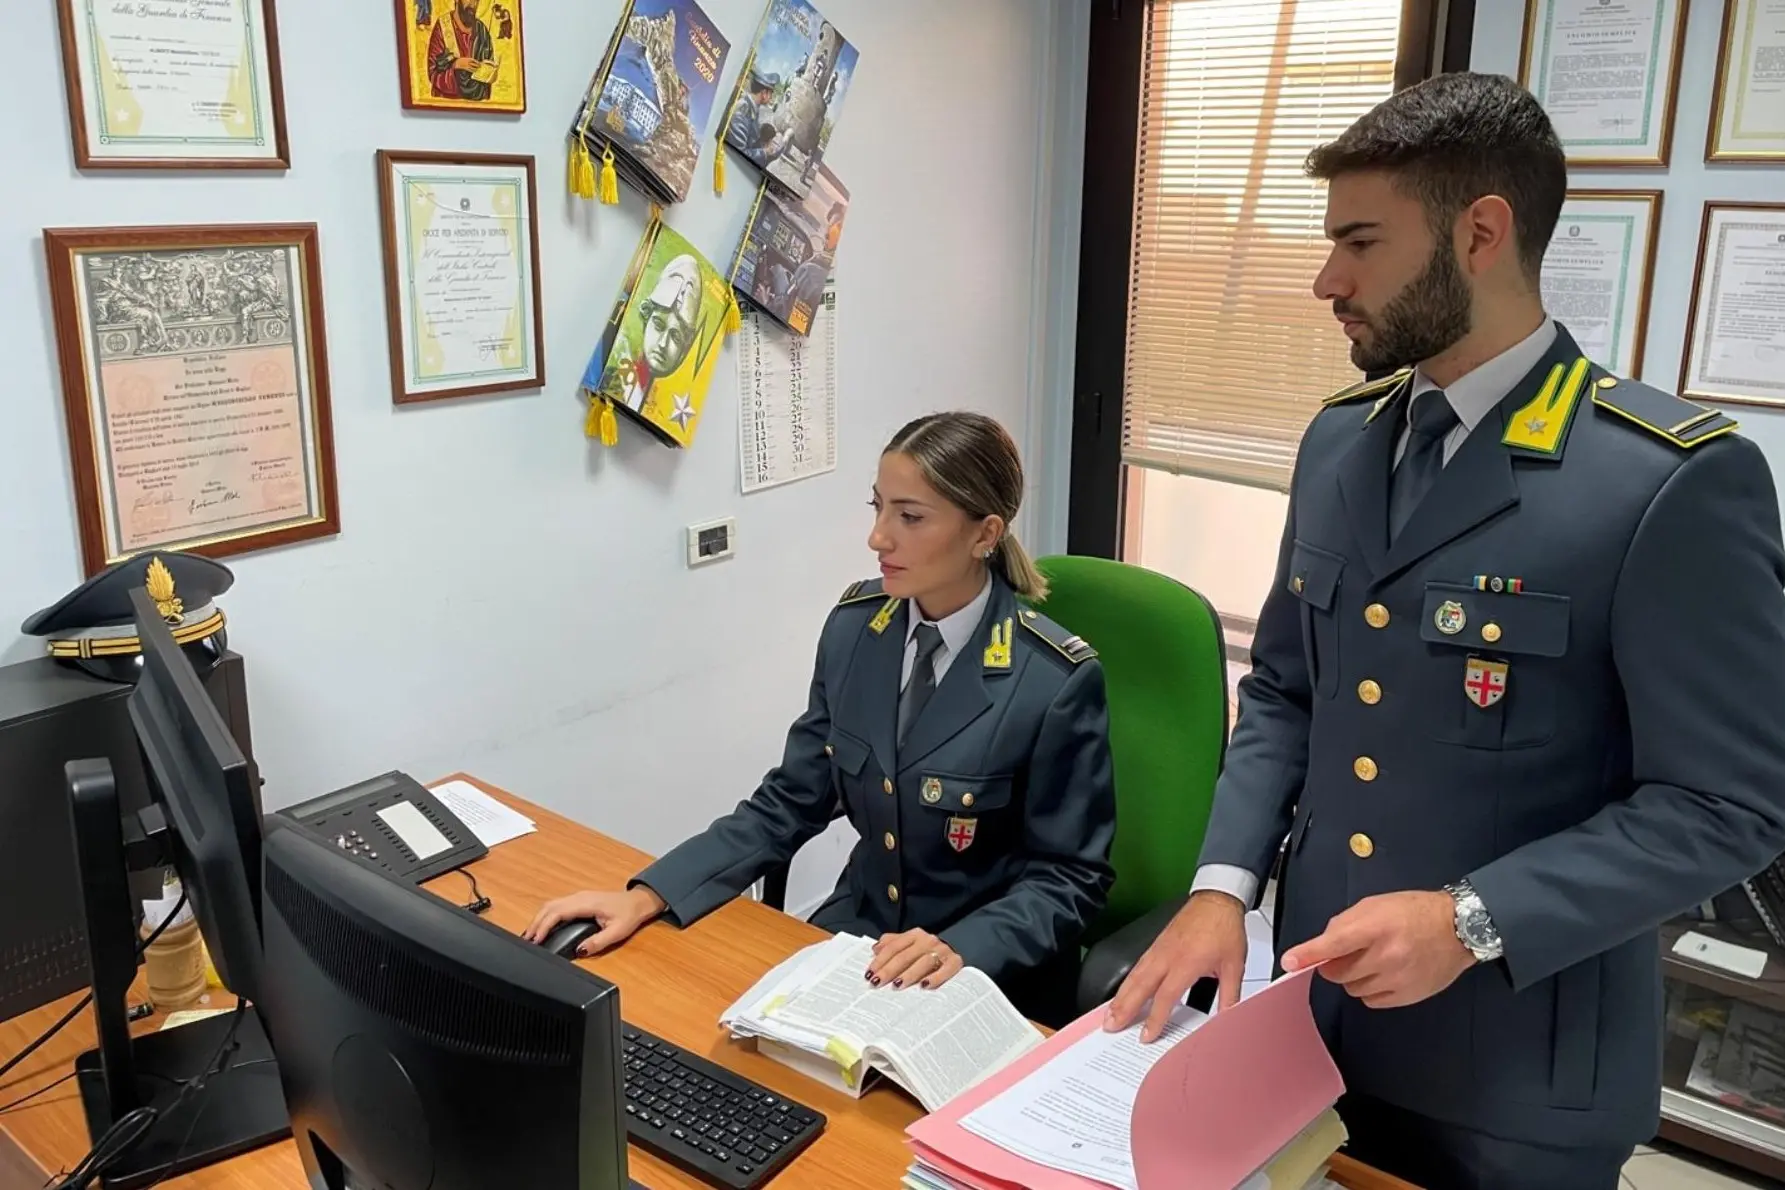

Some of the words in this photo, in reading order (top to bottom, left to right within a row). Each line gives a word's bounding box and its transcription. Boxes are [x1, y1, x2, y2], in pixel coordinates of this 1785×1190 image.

[754, 357, 761, 368] 5
[754, 369, 761, 379] 6
[755, 378, 761, 388] 7
[755, 390, 762, 399] 8
[755, 400, 762, 409] 9
[755, 410, 766, 420] 10
[755, 421, 765, 431] 11
[755, 431, 766, 441] 12
[756, 441, 767, 452] 13
[757, 462, 768, 473] 15
[757, 473, 768, 483] 16
